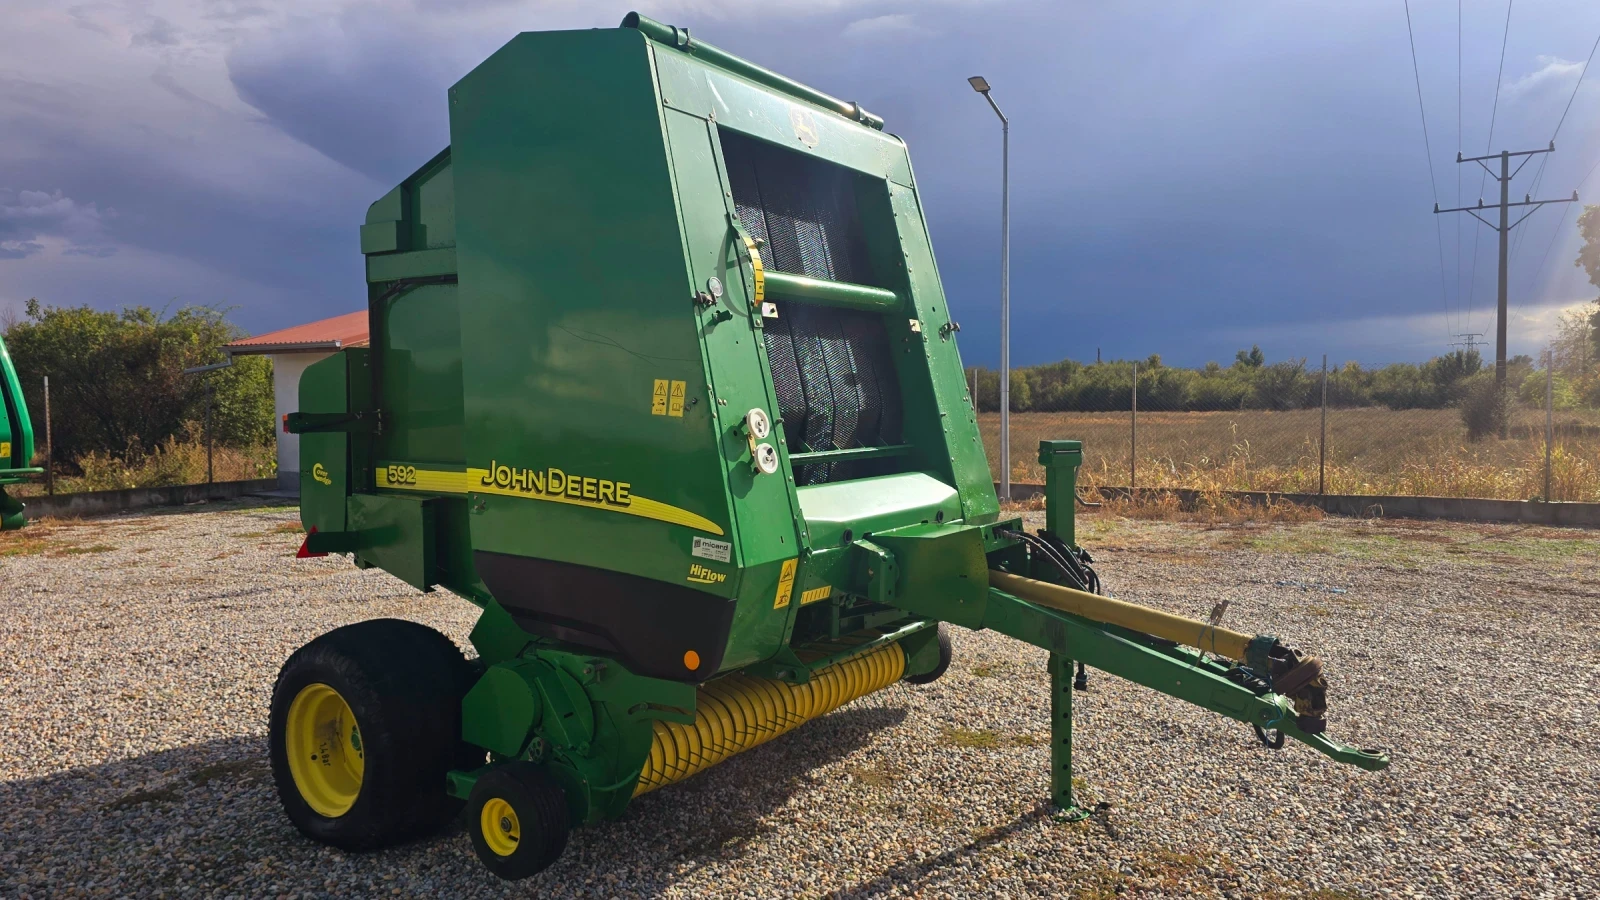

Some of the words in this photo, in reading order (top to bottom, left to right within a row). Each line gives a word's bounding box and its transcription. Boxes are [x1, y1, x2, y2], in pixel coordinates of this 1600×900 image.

[388, 465, 416, 484] 592
[481, 459, 544, 493] JOHN
[546, 467, 631, 507] DEERE
[690, 564, 726, 582] HiFlow
